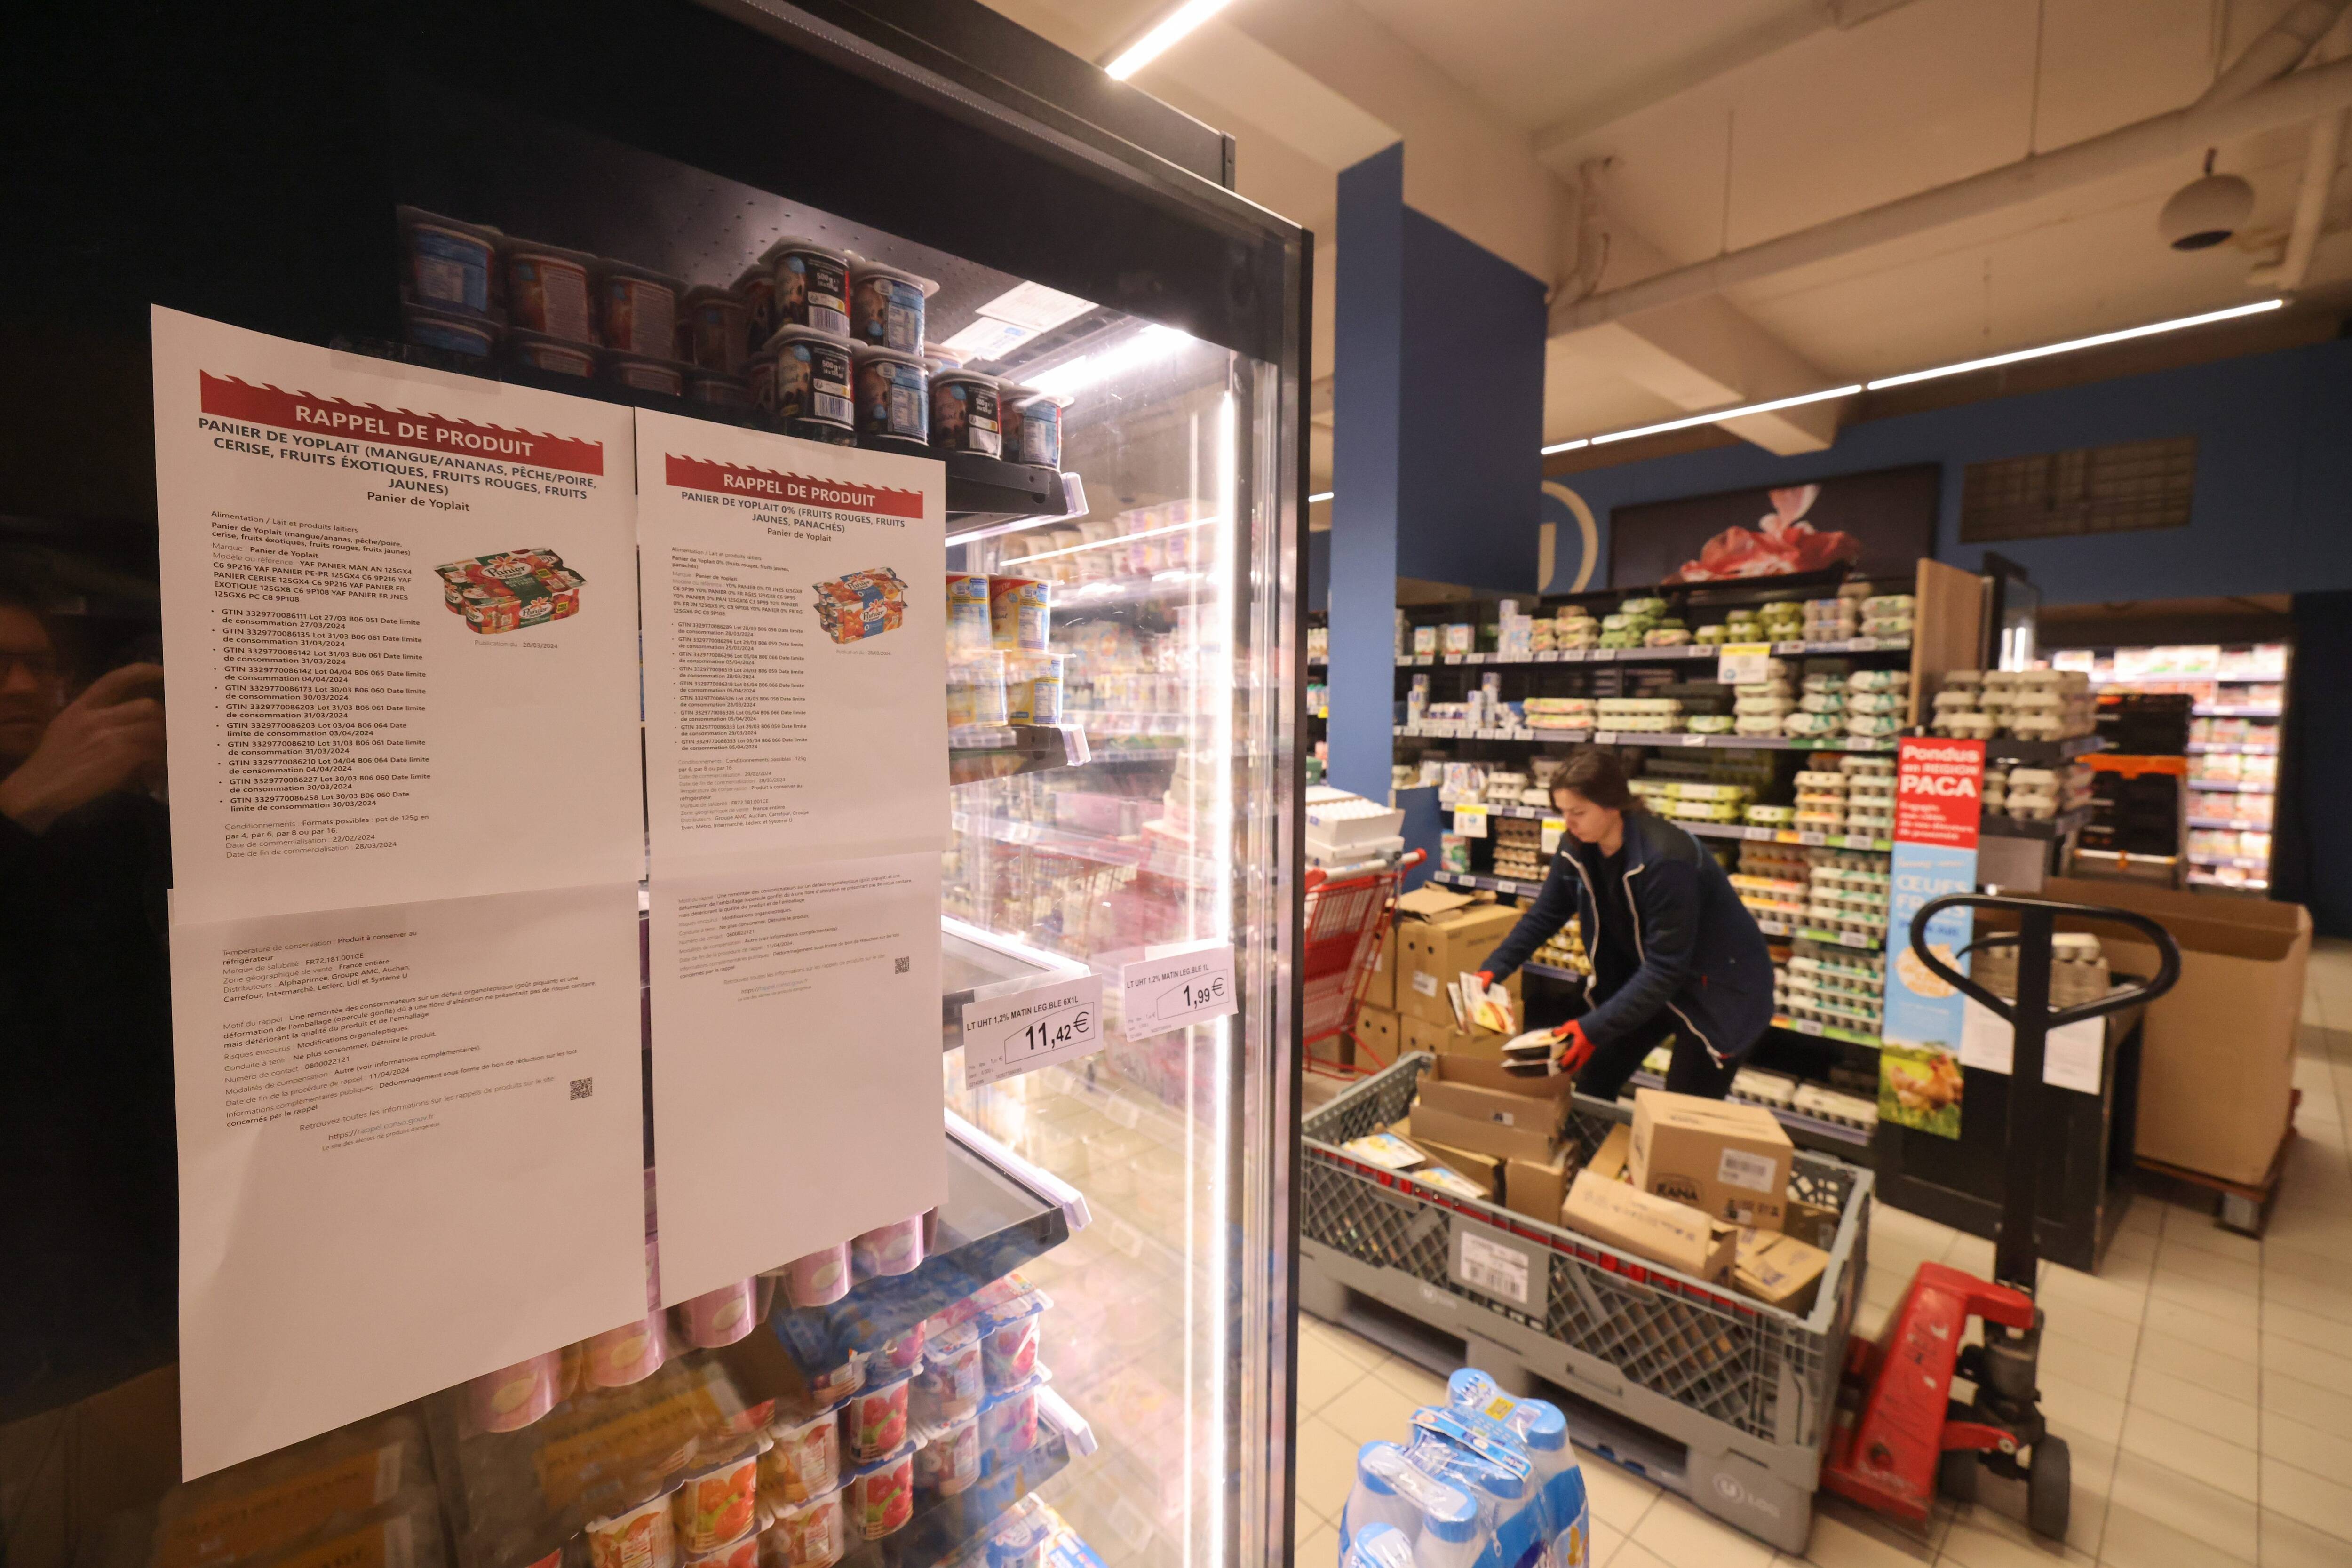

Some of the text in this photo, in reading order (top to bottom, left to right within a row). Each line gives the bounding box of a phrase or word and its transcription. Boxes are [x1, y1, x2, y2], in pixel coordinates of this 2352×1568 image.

[297, 406, 533, 456] RAPPEL DE PRODUIT
[199, 418, 596, 489] PANIER DE YOPLAIT (MANGUE/ANANAS, PÊCHE/POIRE,
[214, 438, 587, 499] CERISE, FRUITS ÉXOTIQUES, FRUITS ROUGES, FRUITS
[388, 478, 448, 496] JAUNES)
[724, 474, 875, 506] RAPPEL DE PRODUIT
[367, 492, 470, 512] Panier de Yoplait
[682, 492, 905, 527] PANIER DE YOPLAIT 0% (FRUITS ROUGES, FRUITS
[211, 511, 263, 522] Alimentation
[752, 514, 845, 533] JAUNES, PANACHÉS)
[265, 537, 306, 547] éxotiques,
[285, 531, 352, 543] (mangue/ananas,
[768, 528, 791, 537] Panier
[806, 533, 831, 542] Yoplait
[485, 565, 525, 577] Panier
[246, 611, 306, 619] 3329770086111
[523, 607, 548, 616] Panier
[863, 610, 884, 620] Panier
[1900, 774, 1976, 797] PACA
[268, 961, 298, 970] salubrité
[246, 971, 299, 983] géographique
[1136, 978, 1146, 987] UHT
[1162, 971, 1178, 980] MATIN
[1180, 965, 1201, 976] LEG.BLE
[967, 996, 1078, 1031] LT UHT 1,2% MATIN LEG.BLE 6X1L
[271, 1067, 298, 1076] contact
[305, 1057, 349, 1070] 0800022121
